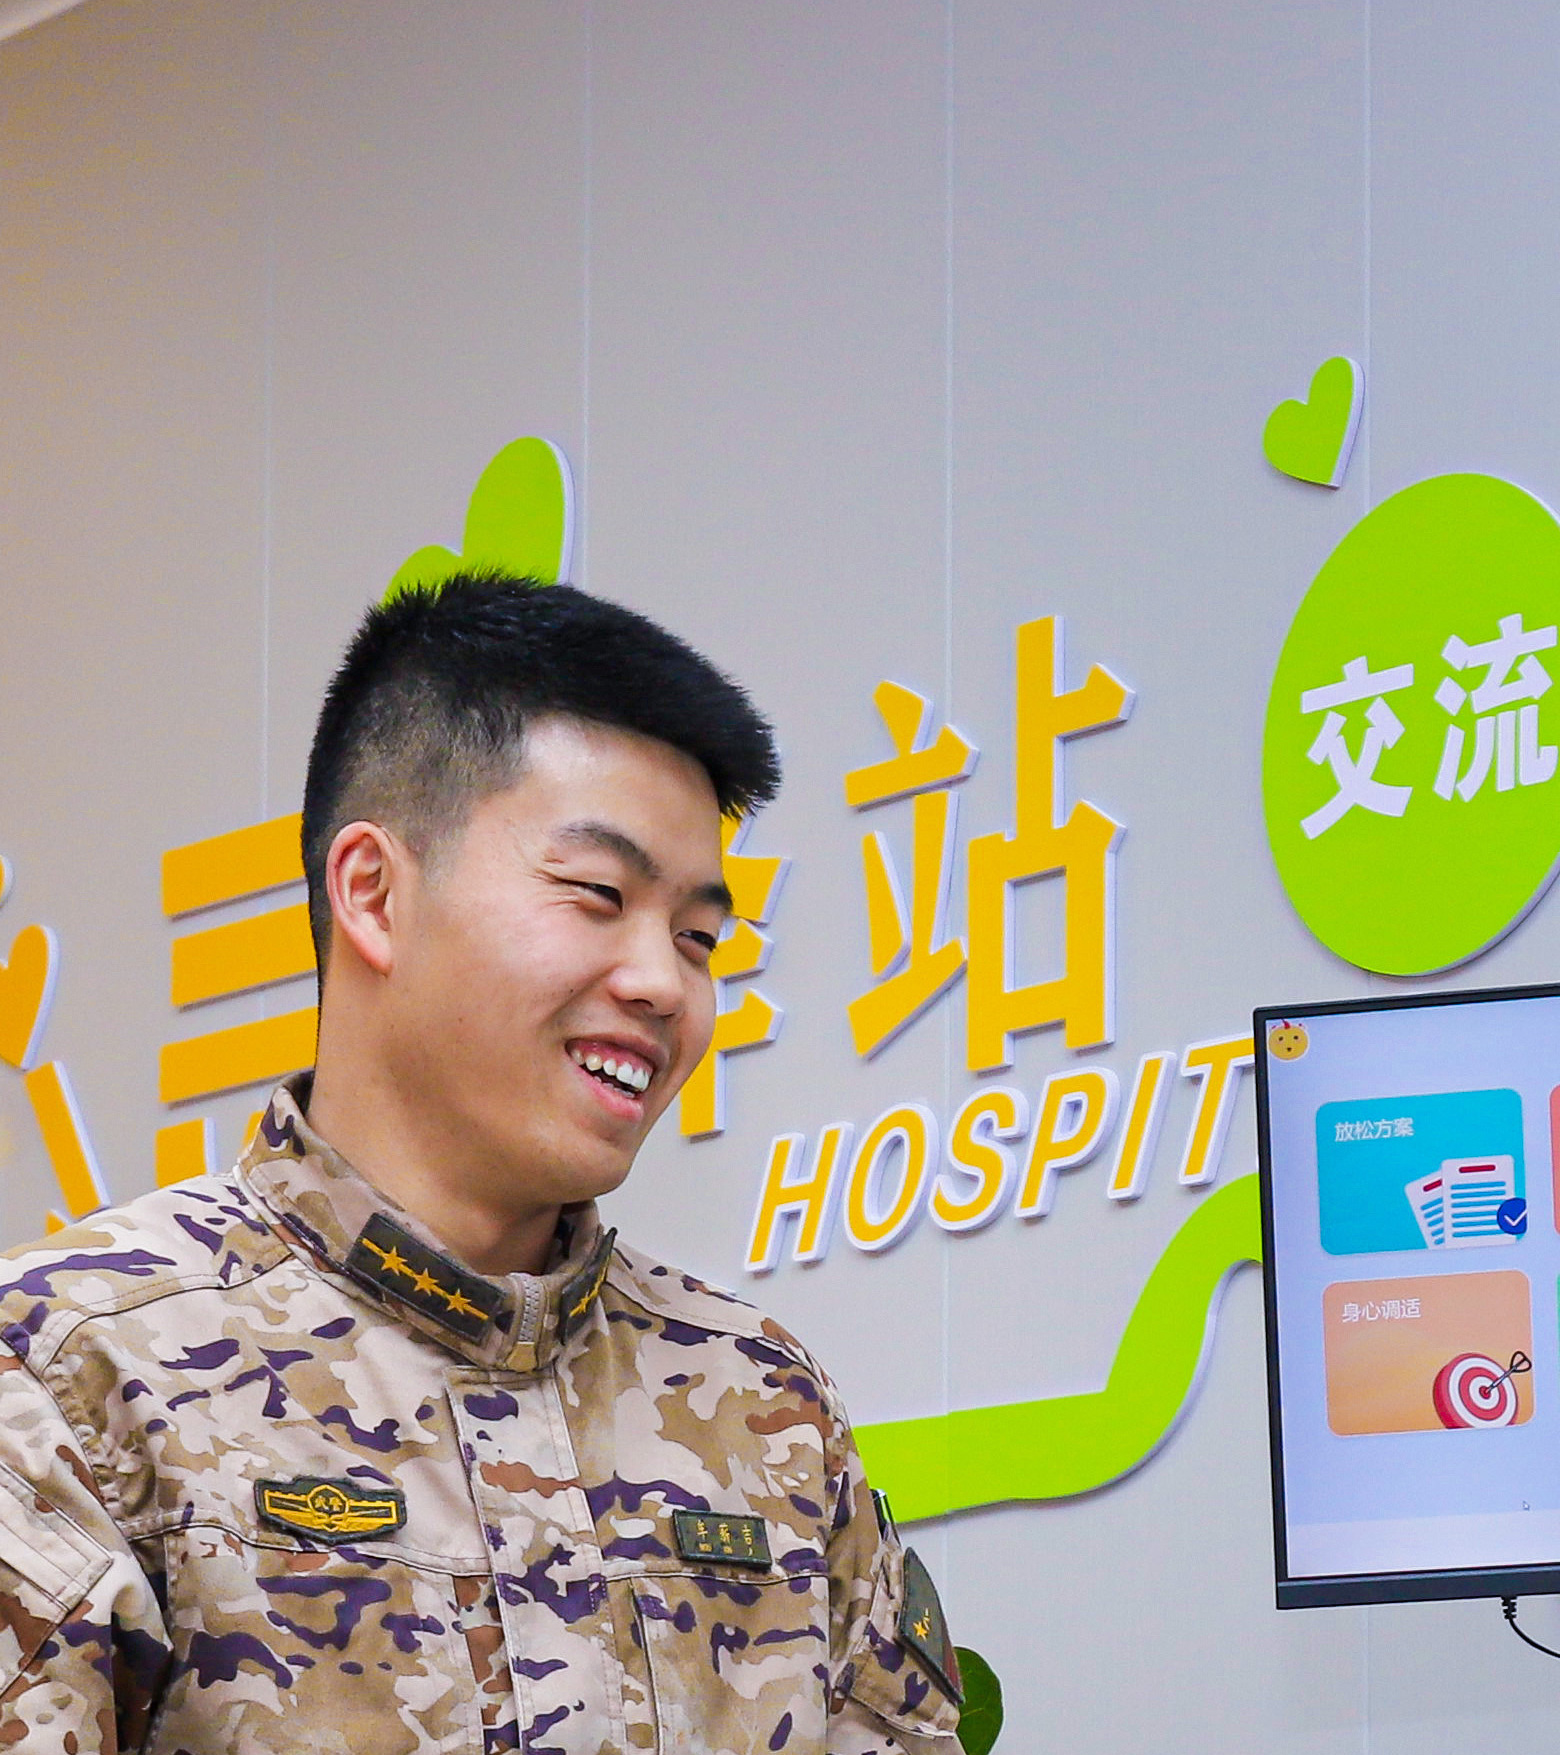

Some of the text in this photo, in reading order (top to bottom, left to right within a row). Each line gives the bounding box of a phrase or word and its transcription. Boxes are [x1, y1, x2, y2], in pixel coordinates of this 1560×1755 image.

[1300, 612, 1559, 840] 交流
[745, 1035, 1254, 1272] HOSPIT
[1334, 1116, 1415, 1142] 放松方案
[1341, 1298, 1422, 1323] 身心调适
